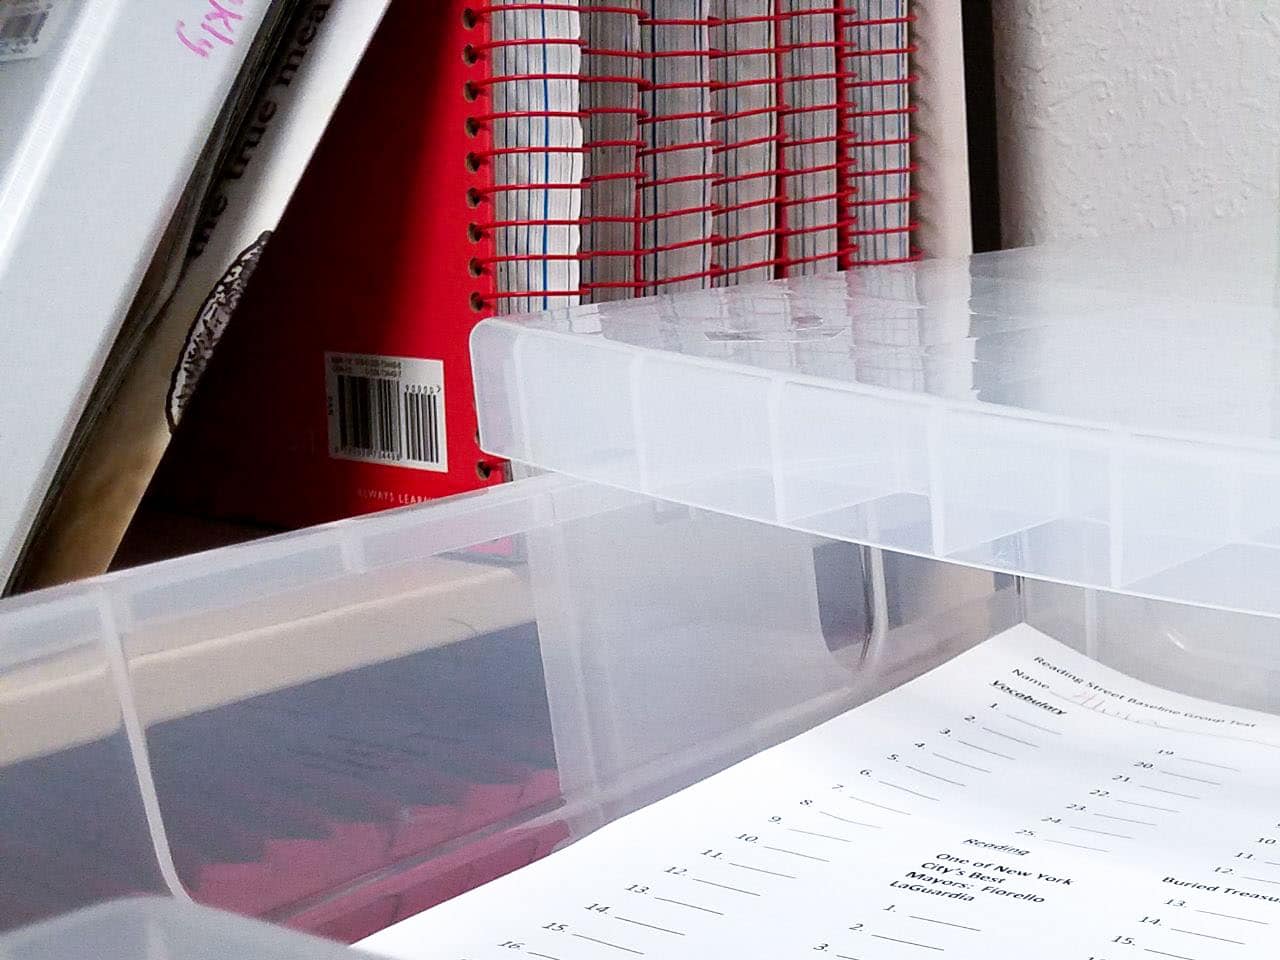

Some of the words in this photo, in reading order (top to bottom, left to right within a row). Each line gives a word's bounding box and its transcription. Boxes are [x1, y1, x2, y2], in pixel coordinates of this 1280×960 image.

[1012, 668, 1050, 689] Name
[1033, 656, 1084, 685] Reading
[1087, 680, 1124, 700] Street
[989, 680, 1067, 716] Vocabulary
[962, 838, 1031, 857] Reading
[920, 861, 967, 877] City's
[969, 871, 1007, 885] Best
[935, 852, 969, 866] One
[972, 858, 994, 870] of
[997, 865, 1033, 878] New
[1036, 871, 1075, 886] York
[888, 880, 975, 902] LaGuardia
[905, 871, 975, 890] Mayors:
[979, 885, 1046, 904] Fiorello
[1162, 875, 1220, 894] Buried
[849, 922, 864, 932] 2.
[812, 943, 829, 952] 3.
[1111, 935, 1136, 947] 15.
